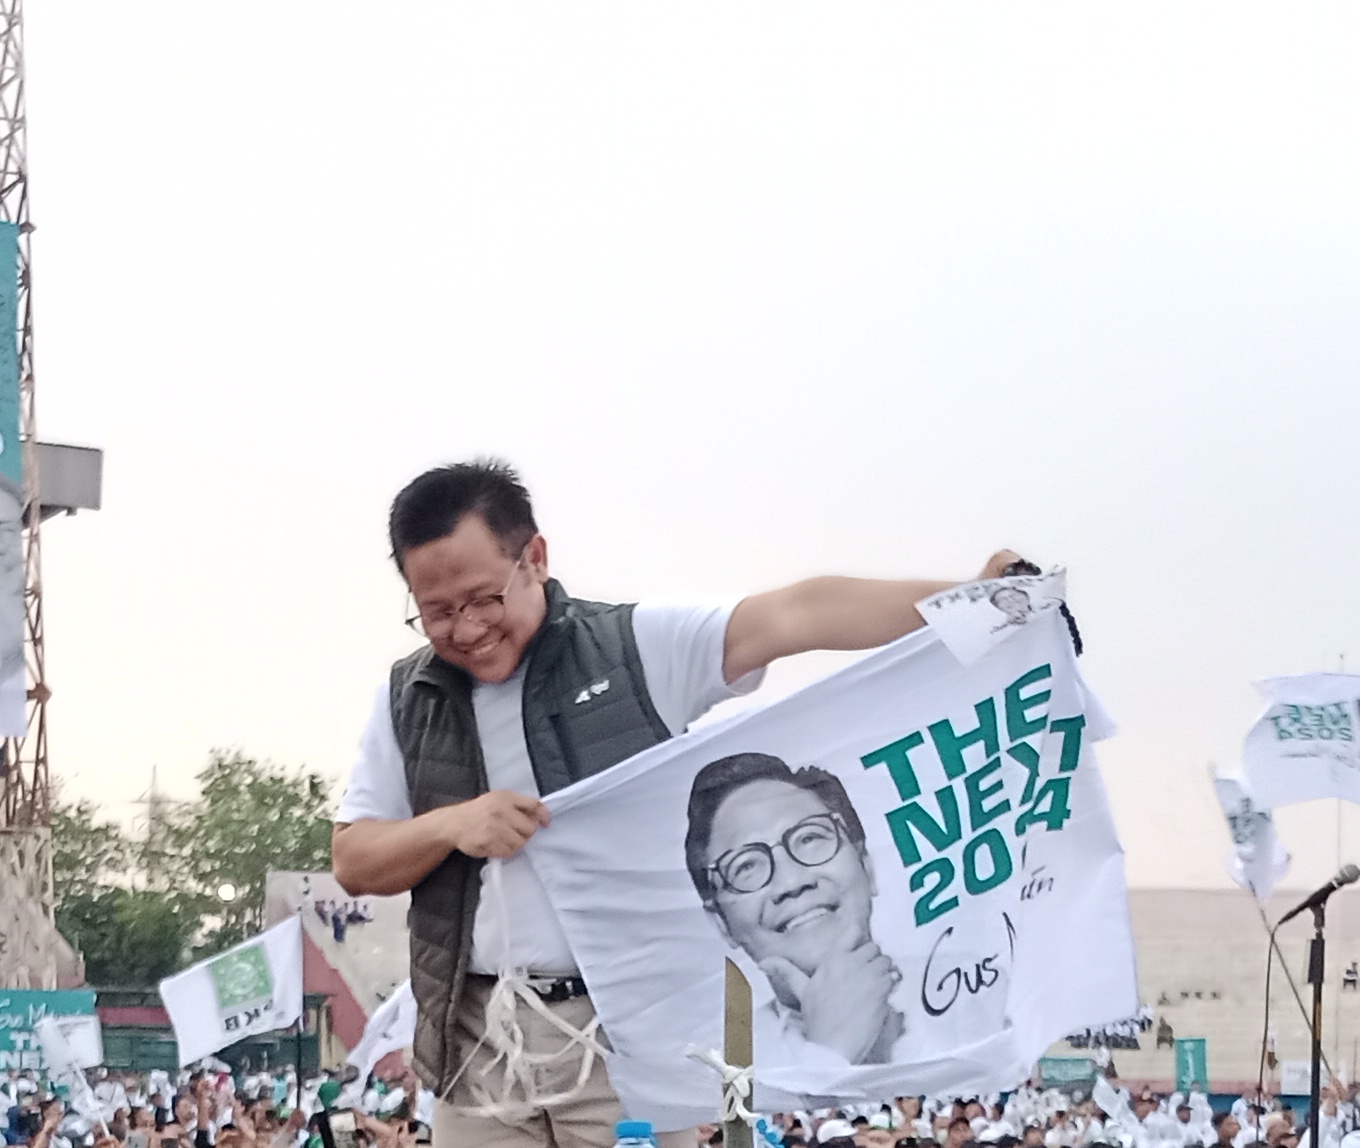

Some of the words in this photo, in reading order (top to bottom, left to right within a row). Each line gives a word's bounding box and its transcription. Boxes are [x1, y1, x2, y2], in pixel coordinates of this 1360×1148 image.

[860, 663, 1052, 802] THE
[909, 776, 1071, 928] 204
[921, 925, 999, 1017] Gus
